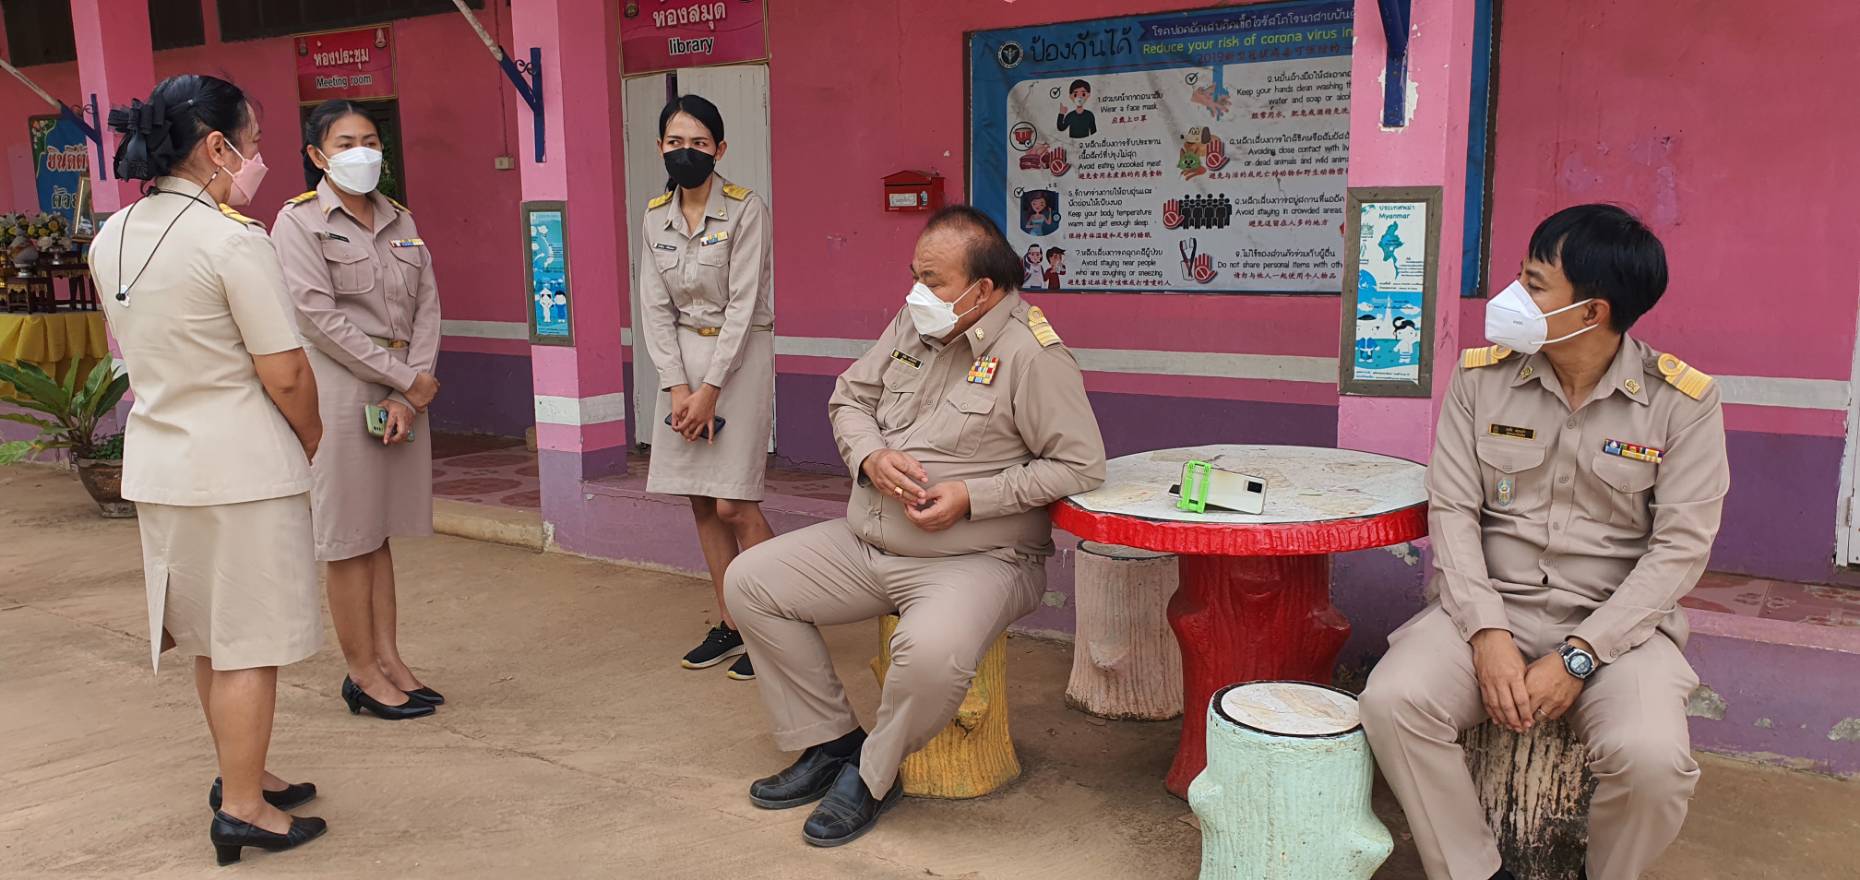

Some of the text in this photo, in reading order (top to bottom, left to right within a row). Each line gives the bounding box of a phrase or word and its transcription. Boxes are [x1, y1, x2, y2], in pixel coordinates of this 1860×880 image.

[669, 37, 714, 55] library
[1143, 43, 1184, 55] Reduce
[1188, 41, 1213, 55] your
[1219, 36, 1239, 48] risk
[1244, 33, 1257, 46] of
[1261, 33, 1303, 45] corona
[1308, 28, 1337, 40] virus
[316, 74, 373, 89] Meeting room
[1237, 88, 1253, 97] Keep
[1256, 88, 1271, 98] your
[1296, 83, 1312, 91] clean
[1316, 82, 1343, 91] washing
[1306, 95, 1321, 103] soap
[1126, 104, 1140, 112] face
[1248, 147, 1276, 156] Avoiding
[1298, 145, 1321, 153] contact
[1325, 144, 1339, 152] with
[1098, 162, 1115, 170] eating
[1117, 160, 1144, 168] uncooked
[1100, 210, 1114, 218] body
[1257, 208, 1280, 217] staying
[1291, 206, 1320, 214] crowded
[1378, 212, 1411, 220] Myanmar
[1100, 260, 1120, 268] staying
[1138, 260, 1156, 268] people
[1263, 260, 1289, 269] personal
[1102, 270, 1126, 278] coughing
[1138, 270, 1163, 278] sneezing
